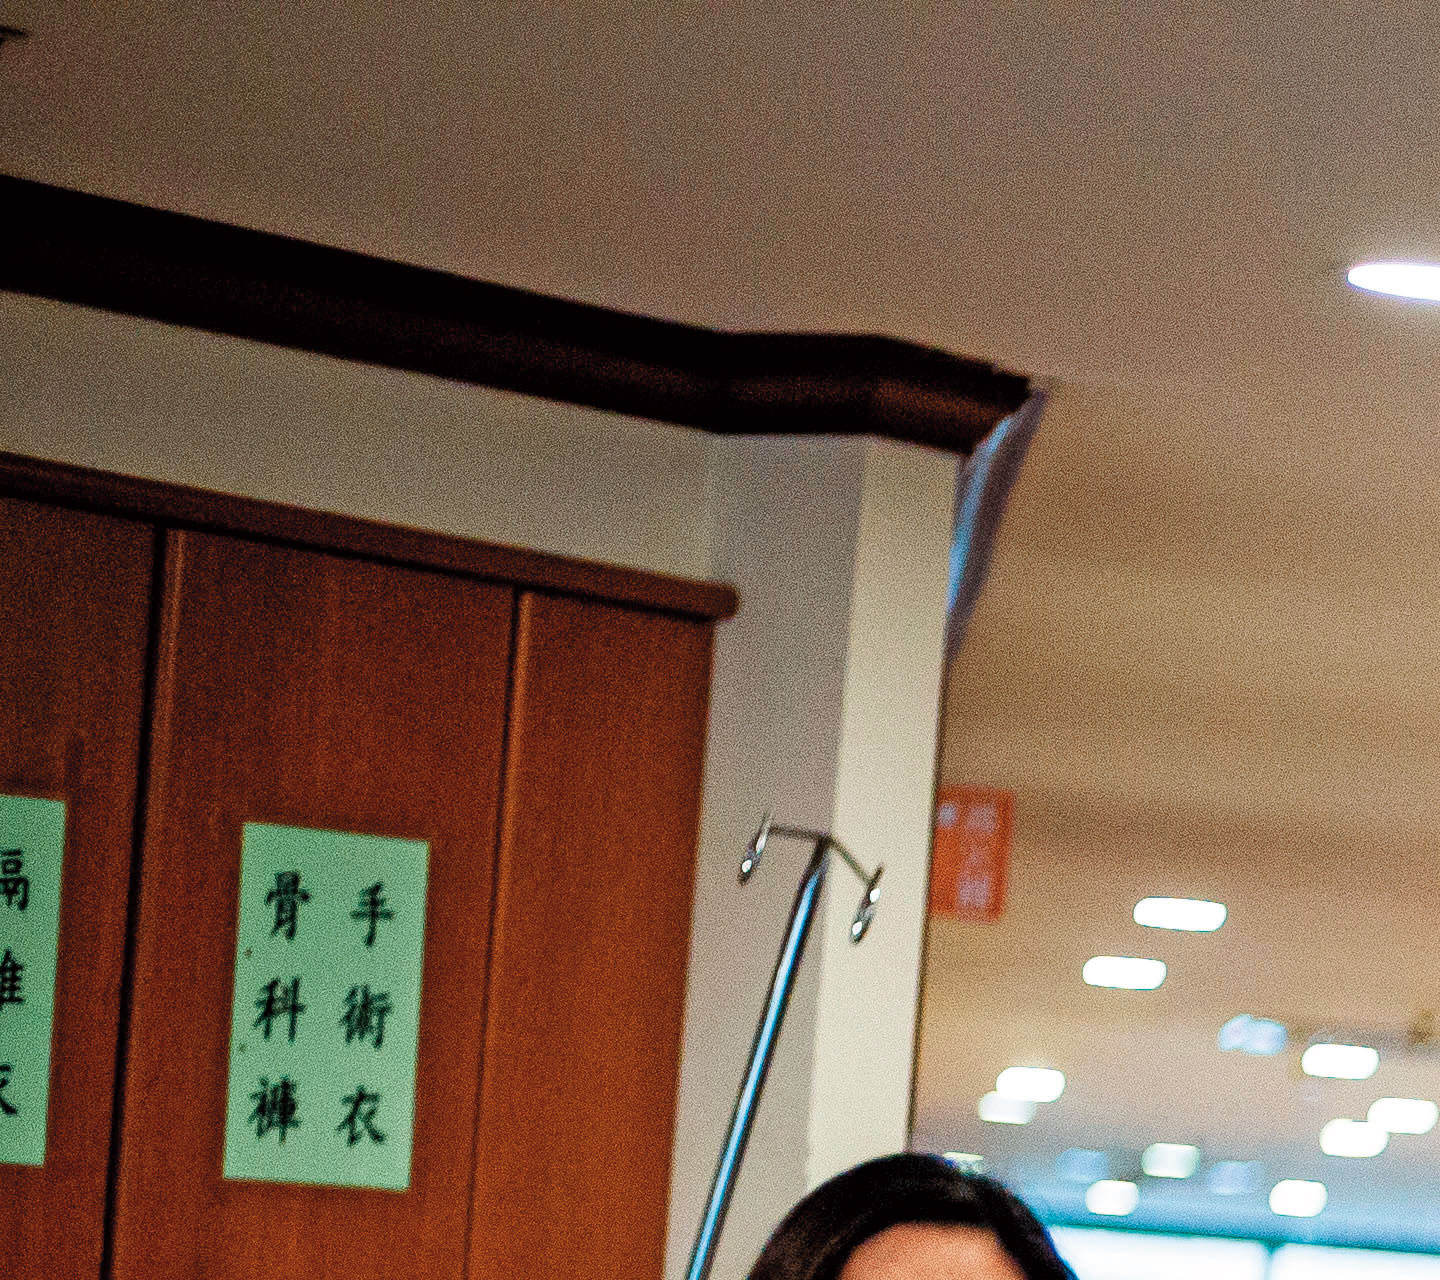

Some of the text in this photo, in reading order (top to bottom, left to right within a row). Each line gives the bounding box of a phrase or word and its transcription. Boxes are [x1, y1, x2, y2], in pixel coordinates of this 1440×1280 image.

[248, 868, 312, 1148] 骨科褲
[335, 880, 395, 1147] 手術衣
